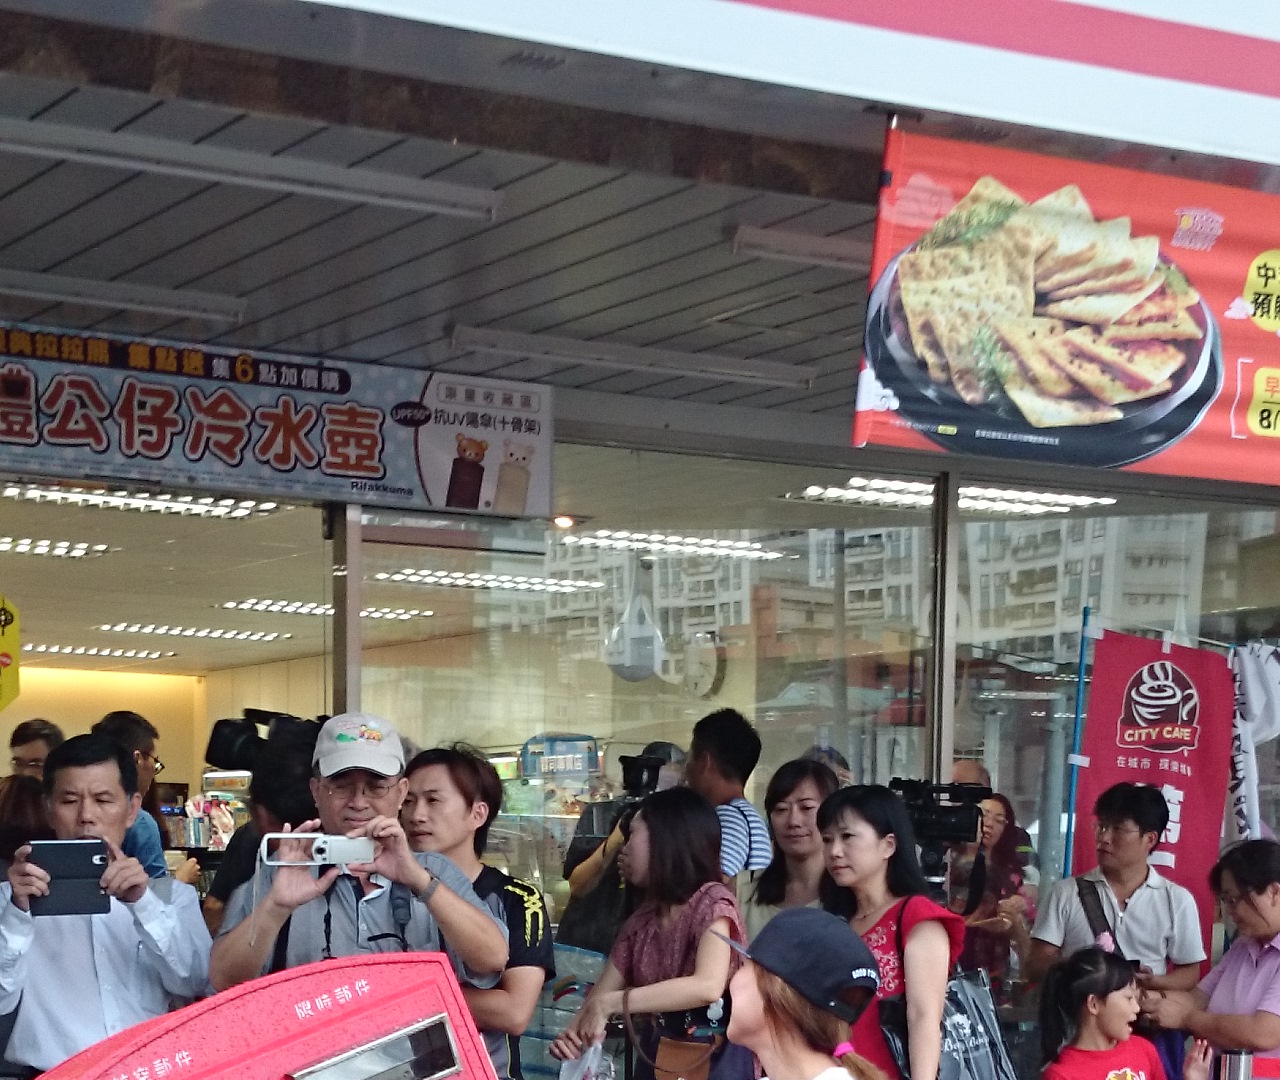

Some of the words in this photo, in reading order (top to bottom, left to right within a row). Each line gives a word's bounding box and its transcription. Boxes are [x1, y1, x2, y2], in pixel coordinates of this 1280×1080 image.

[1124, 728, 1159, 742] CITY
[294, 978, 372, 1021] 限時郵件
